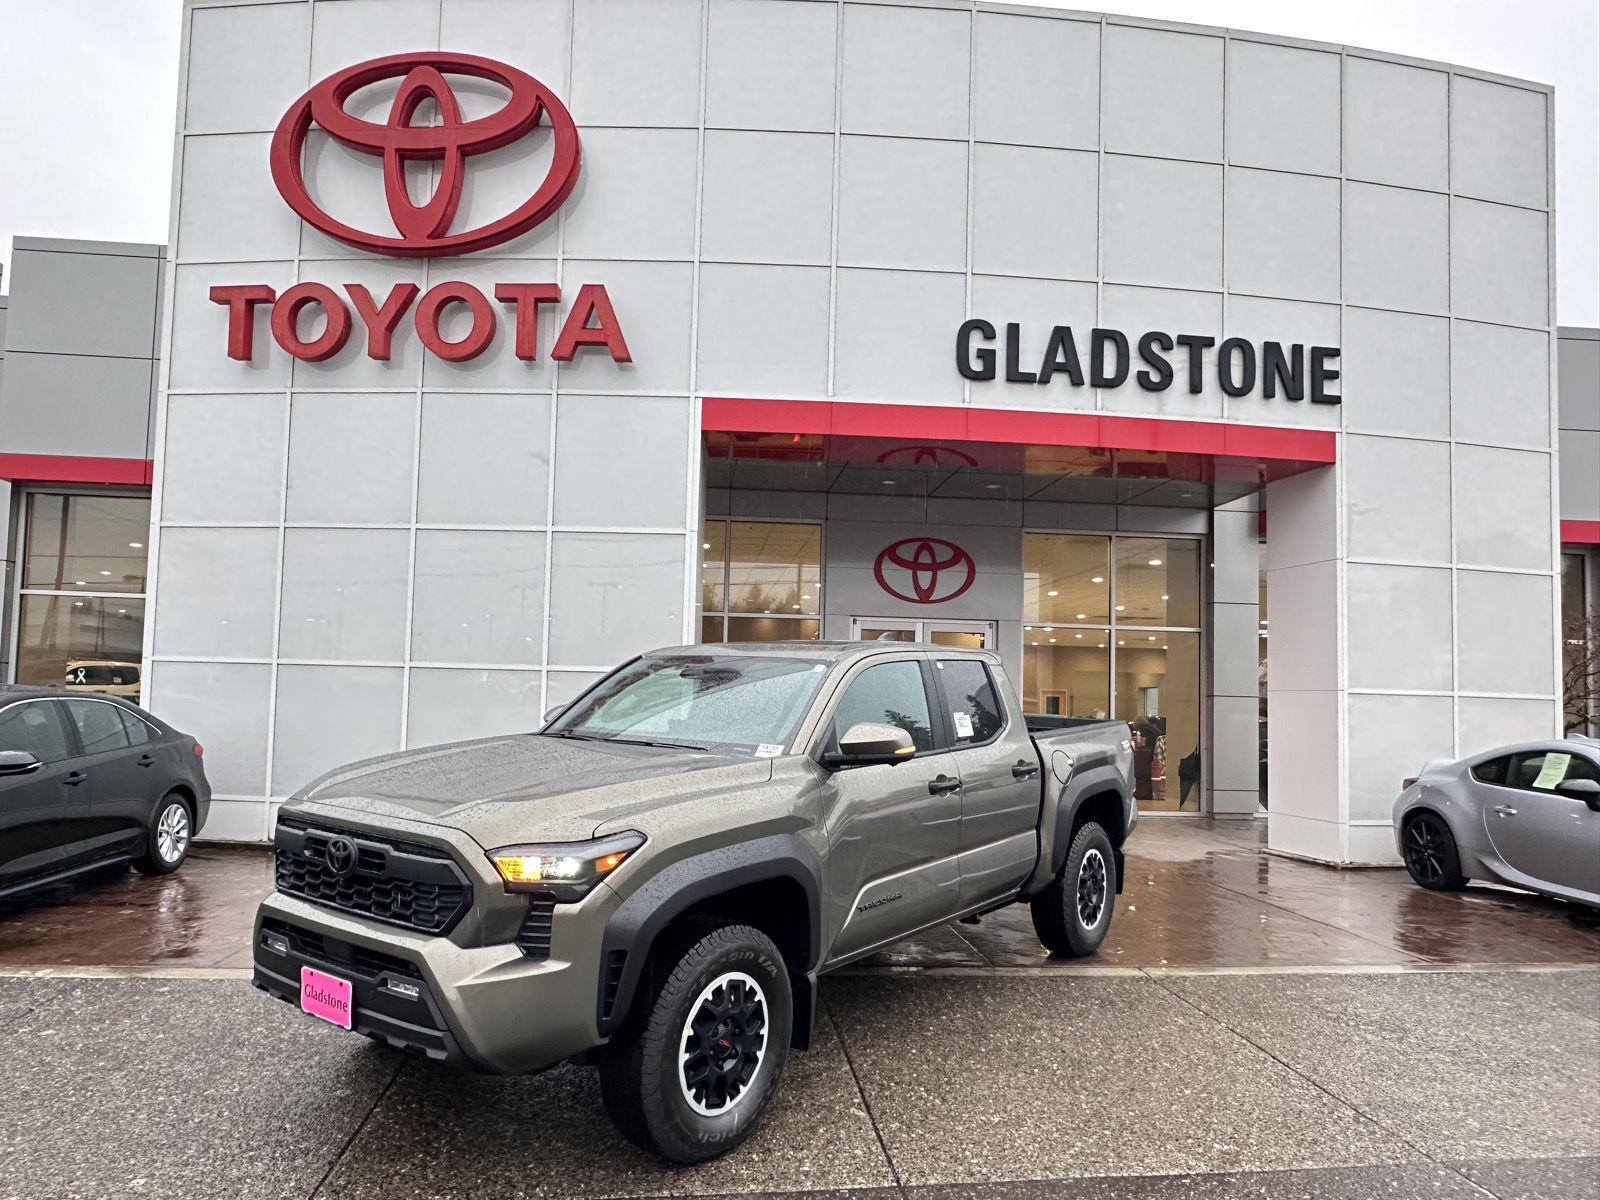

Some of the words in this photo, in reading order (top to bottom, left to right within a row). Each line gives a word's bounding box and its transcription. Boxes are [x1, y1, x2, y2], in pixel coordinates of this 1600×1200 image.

[209, 281, 632, 363] TOYOTA
[956, 318, 1341, 404] GLADSTONE
[304, 983, 348, 1013] Gladstone
